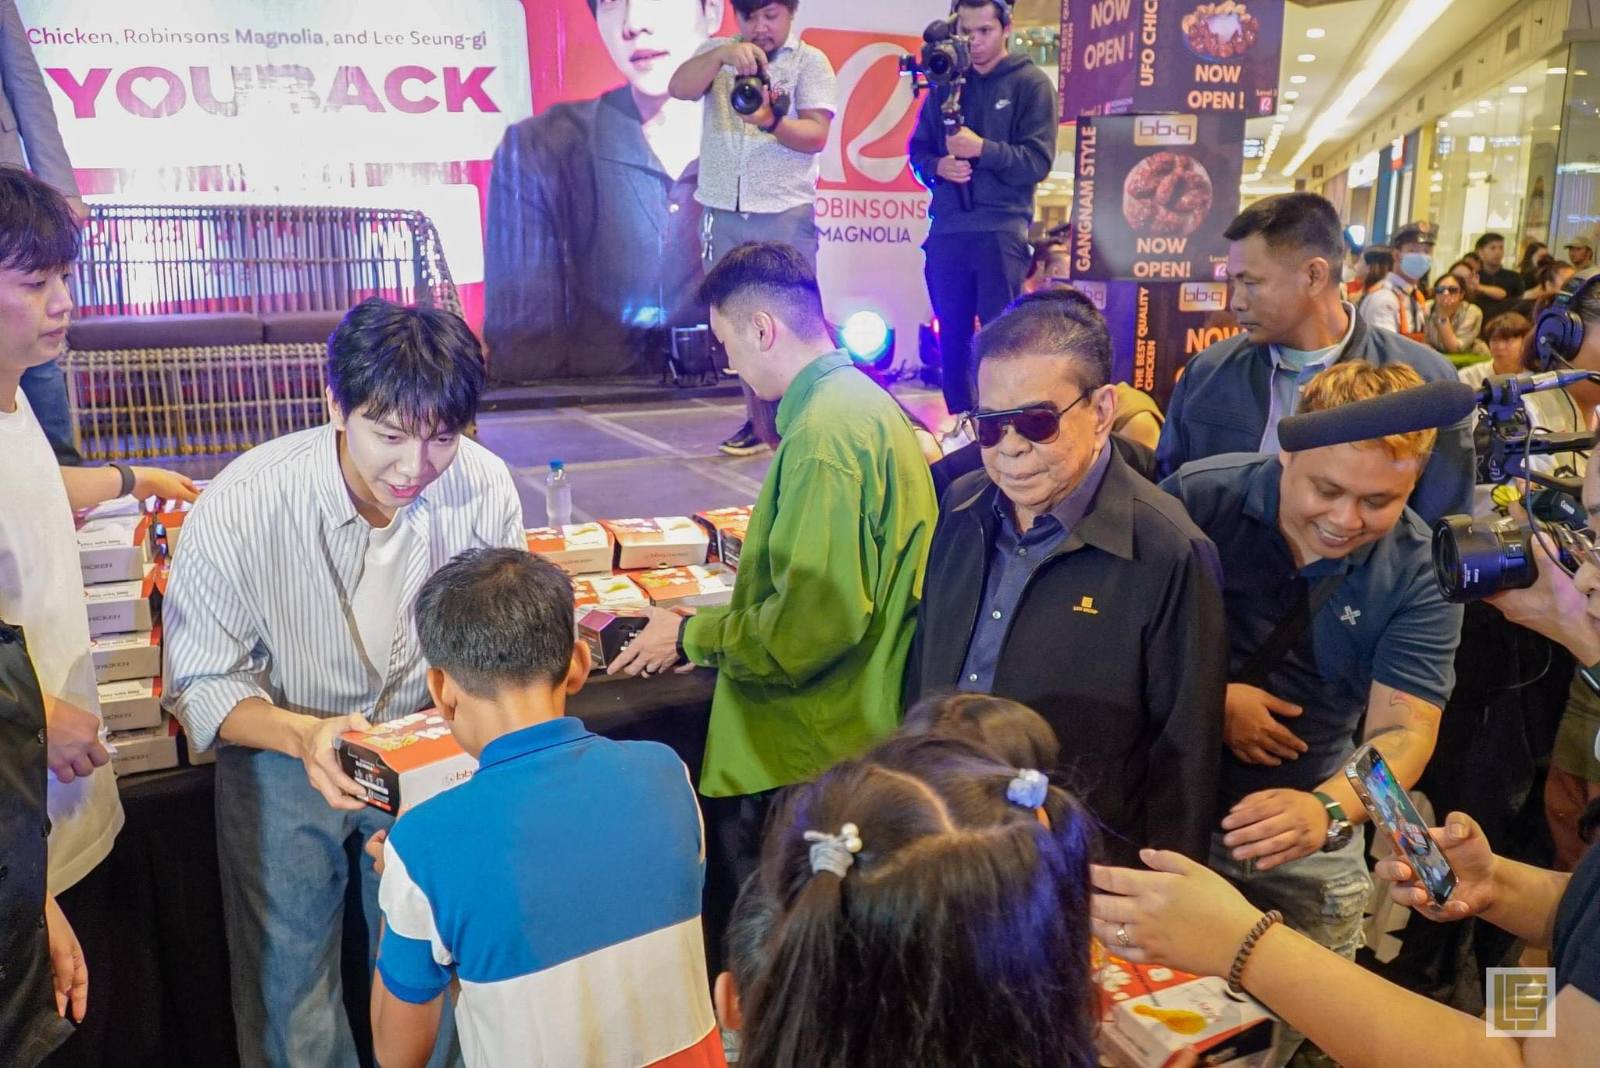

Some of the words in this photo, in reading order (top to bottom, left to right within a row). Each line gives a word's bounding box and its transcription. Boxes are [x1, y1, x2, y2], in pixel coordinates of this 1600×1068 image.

[1090, 0, 1131, 30] NOW
[1142, 0, 1158, 46] CHIC
[26, 27, 119, 45] Chicken,
[123, 28, 230, 45] Robinsons
[235, 28, 330, 48] Magnolia,
[333, 30, 368, 45] and
[374, 31, 405, 45] Lee
[410, 31, 488, 50] Seung-gi
[1084, 35, 1126, 70] OPEN
[1140, 48, 1155, 87] UFO
[1195, 64, 1241, 84] NOW
[1187, 91, 1235, 110] OPEN
[1080, 126, 1096, 177] STYLE
[816, 197, 927, 219] OBINSONS
[818, 226, 912, 243] MAGNOLIA
[1076, 180, 1095, 272] GANGNAM
[1137, 237, 1187, 254] NOW
[1133, 261, 1191, 278] OPEN!
[1138, 286, 1150, 337] QUALITY
[1136, 340, 1146, 368] BEST
[1145, 340, 1156, 391] CHICKEN
[1135, 369, 1145, 389] THE
